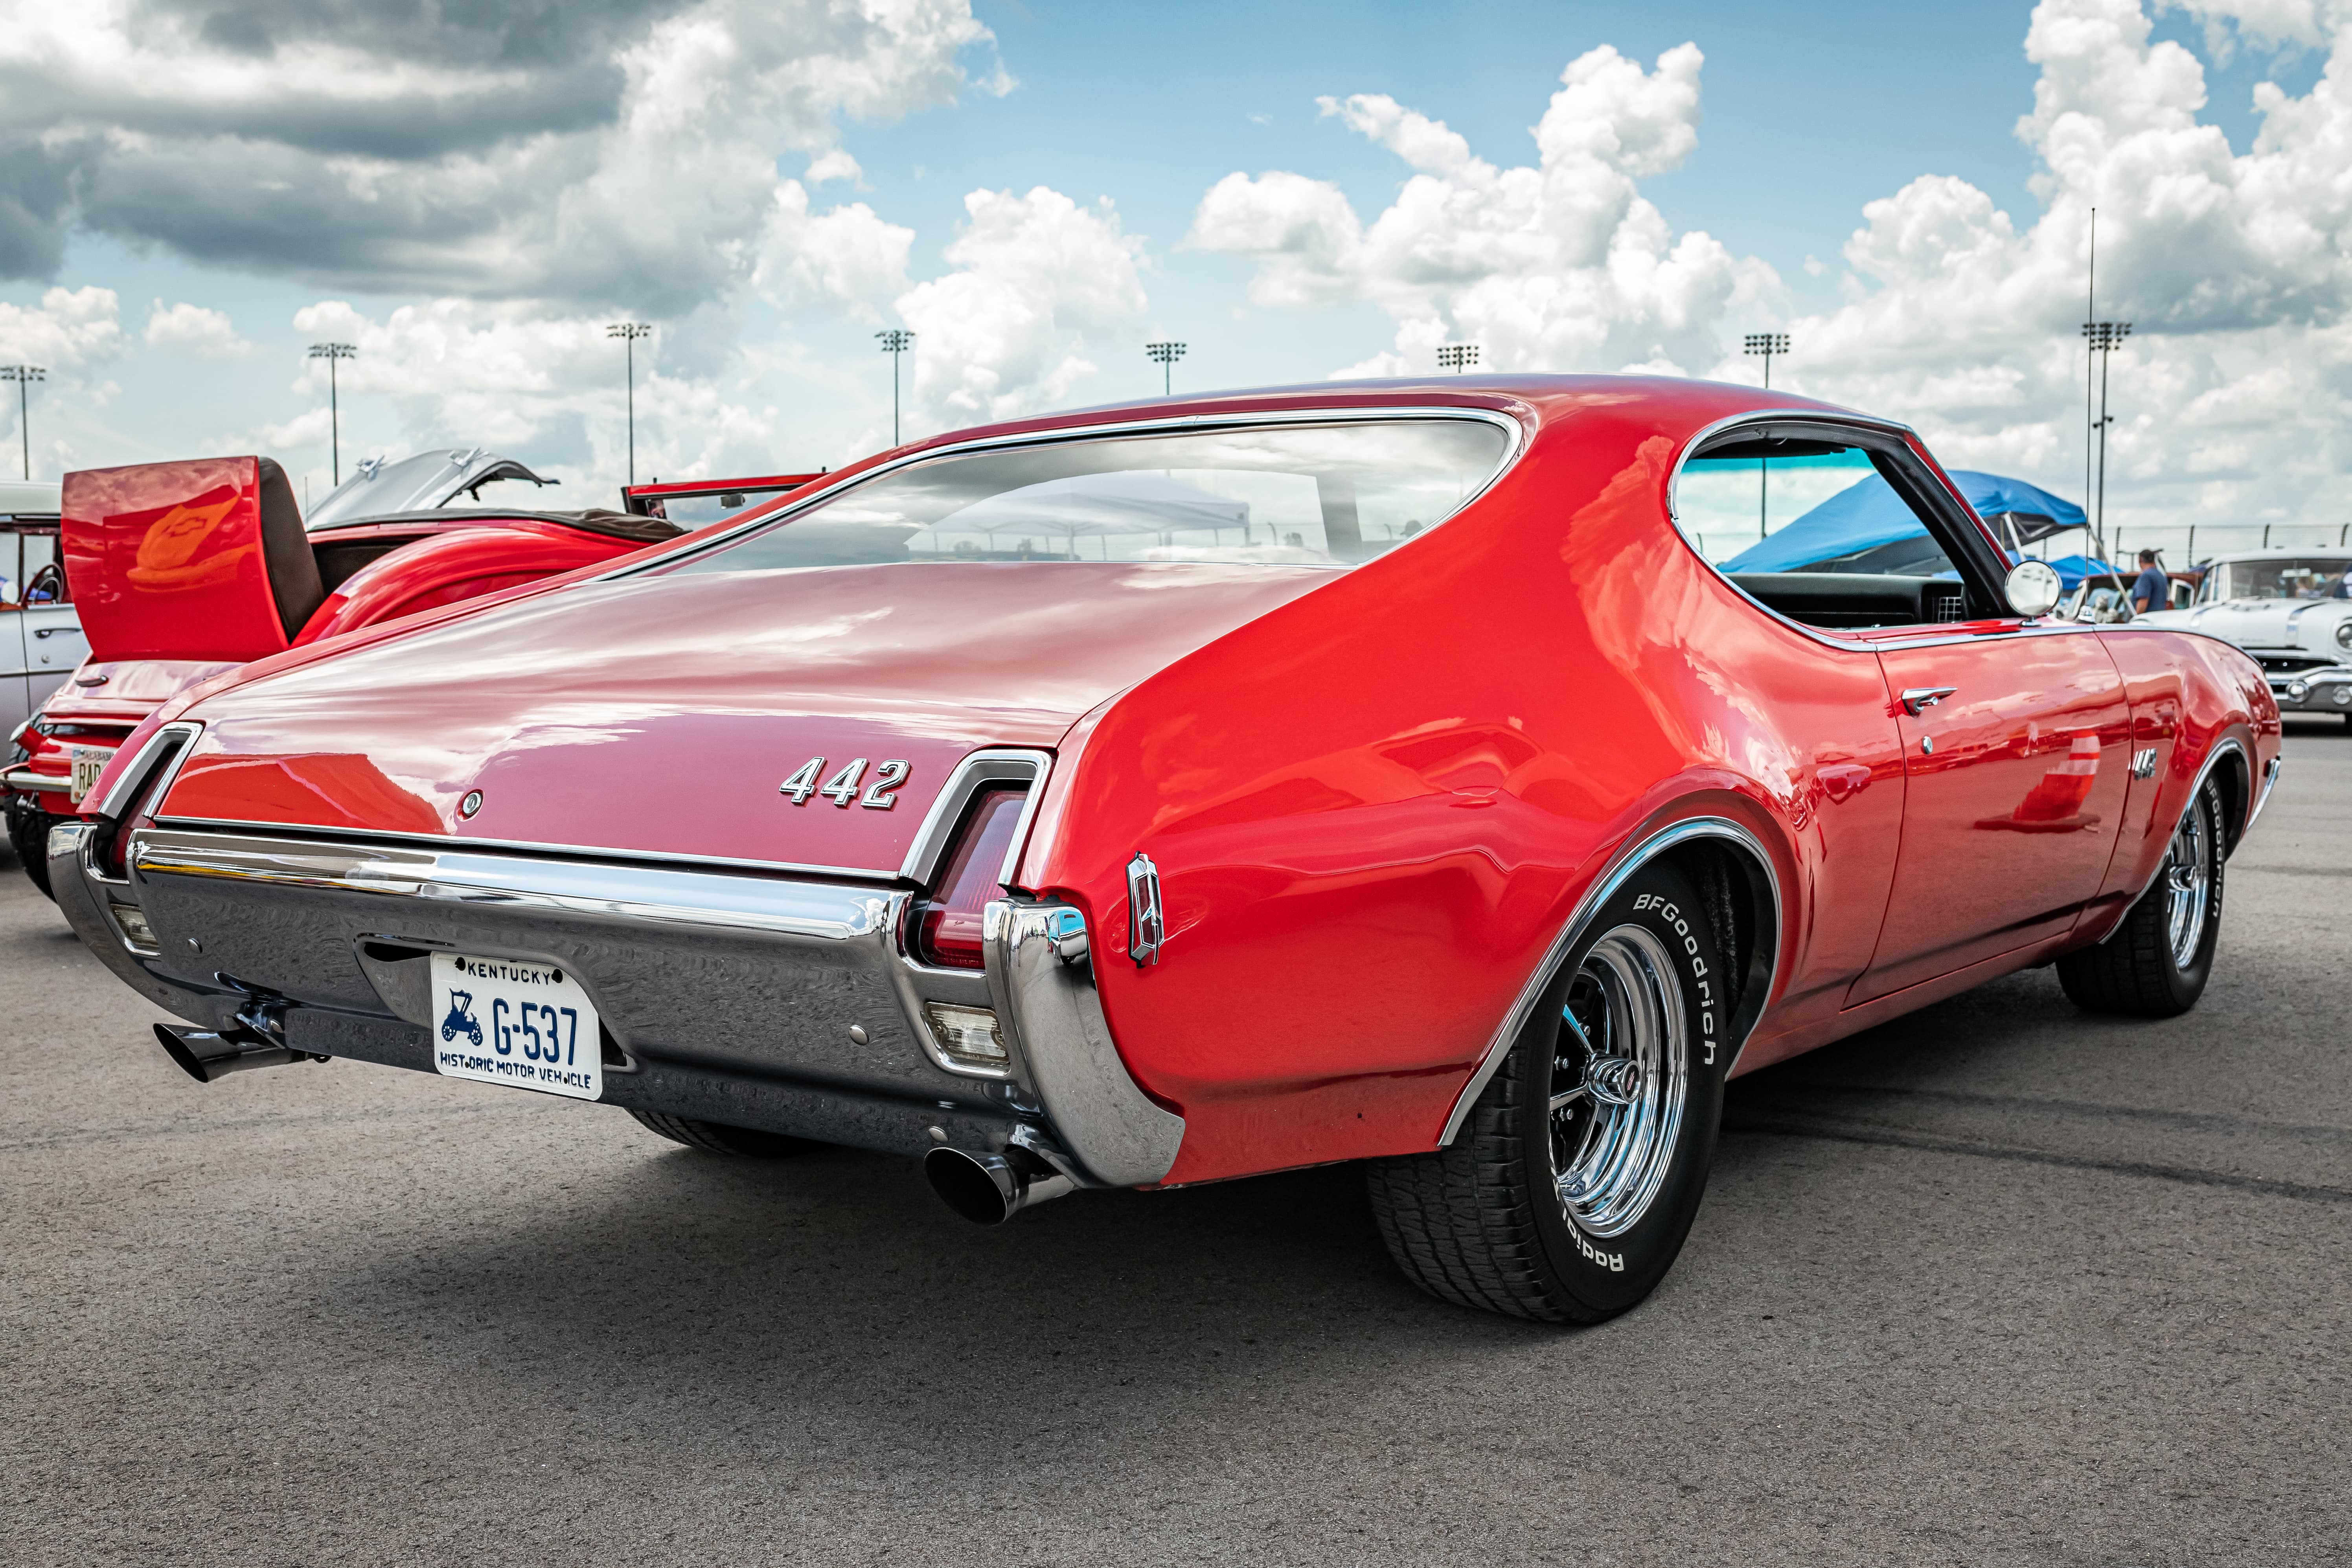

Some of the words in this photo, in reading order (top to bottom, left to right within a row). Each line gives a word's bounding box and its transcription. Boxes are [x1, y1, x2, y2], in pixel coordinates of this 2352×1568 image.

[779, 756, 909, 809] 442
[468, 962, 550, 985] KENTUCKY
[1633, 894, 1716, 1064] BFGoodrich
[493, 998, 577, 1066] G-537
[440, 1051, 493, 1072] HISTORIC
[497, 1060, 535, 1078] MOTOR
[539, 1068, 591, 1089] VEHICLE
[1563, 1208, 1624, 1272] Radial
